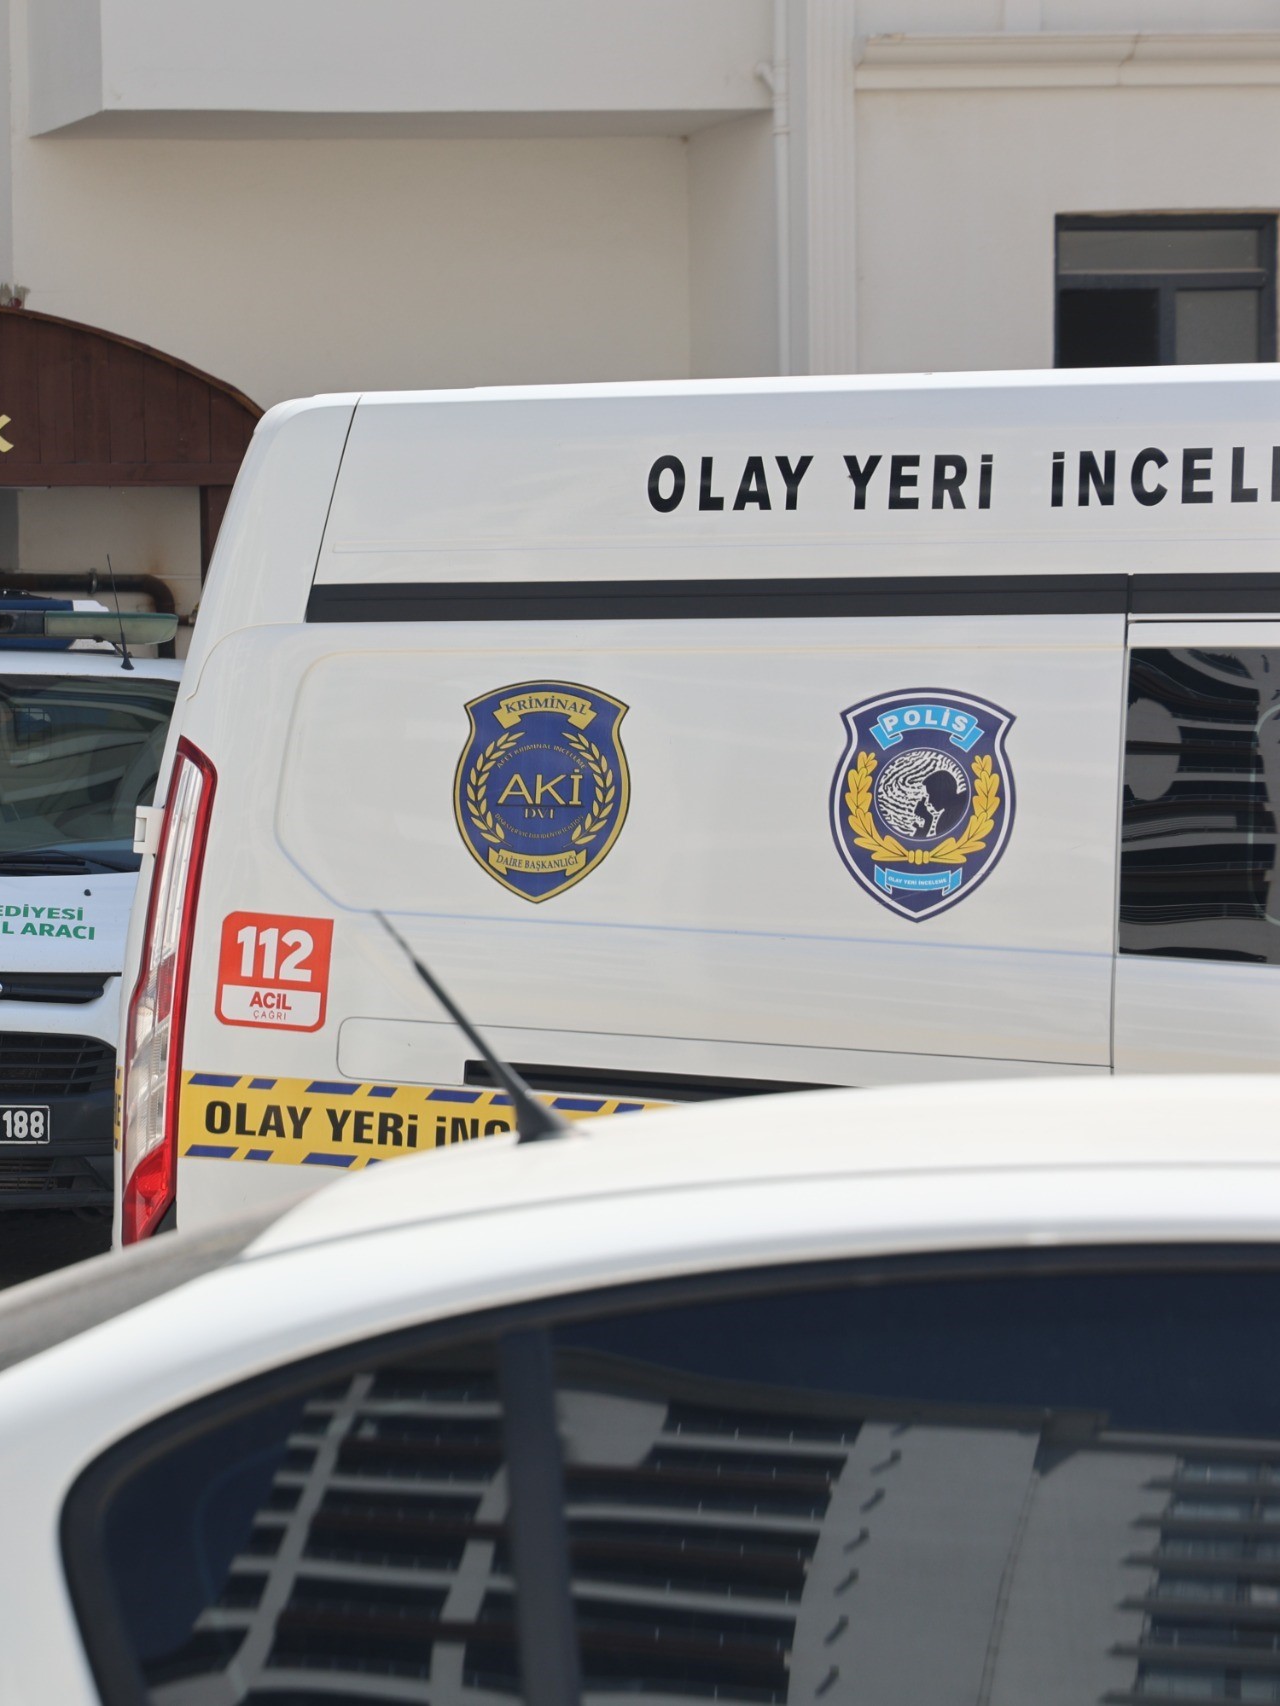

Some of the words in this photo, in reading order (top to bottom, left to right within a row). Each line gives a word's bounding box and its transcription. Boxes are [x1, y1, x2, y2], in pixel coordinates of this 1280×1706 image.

[647, 455, 814, 513] OLAY
[883, 709, 969, 732] POLİS
[497, 768, 584, 805] AKİ
[20, 921, 95, 940] ARACI
[237, 925, 314, 983] 112
[2, 1110, 45, 1139] 188
[204, 1100, 311, 1140] OLAY
